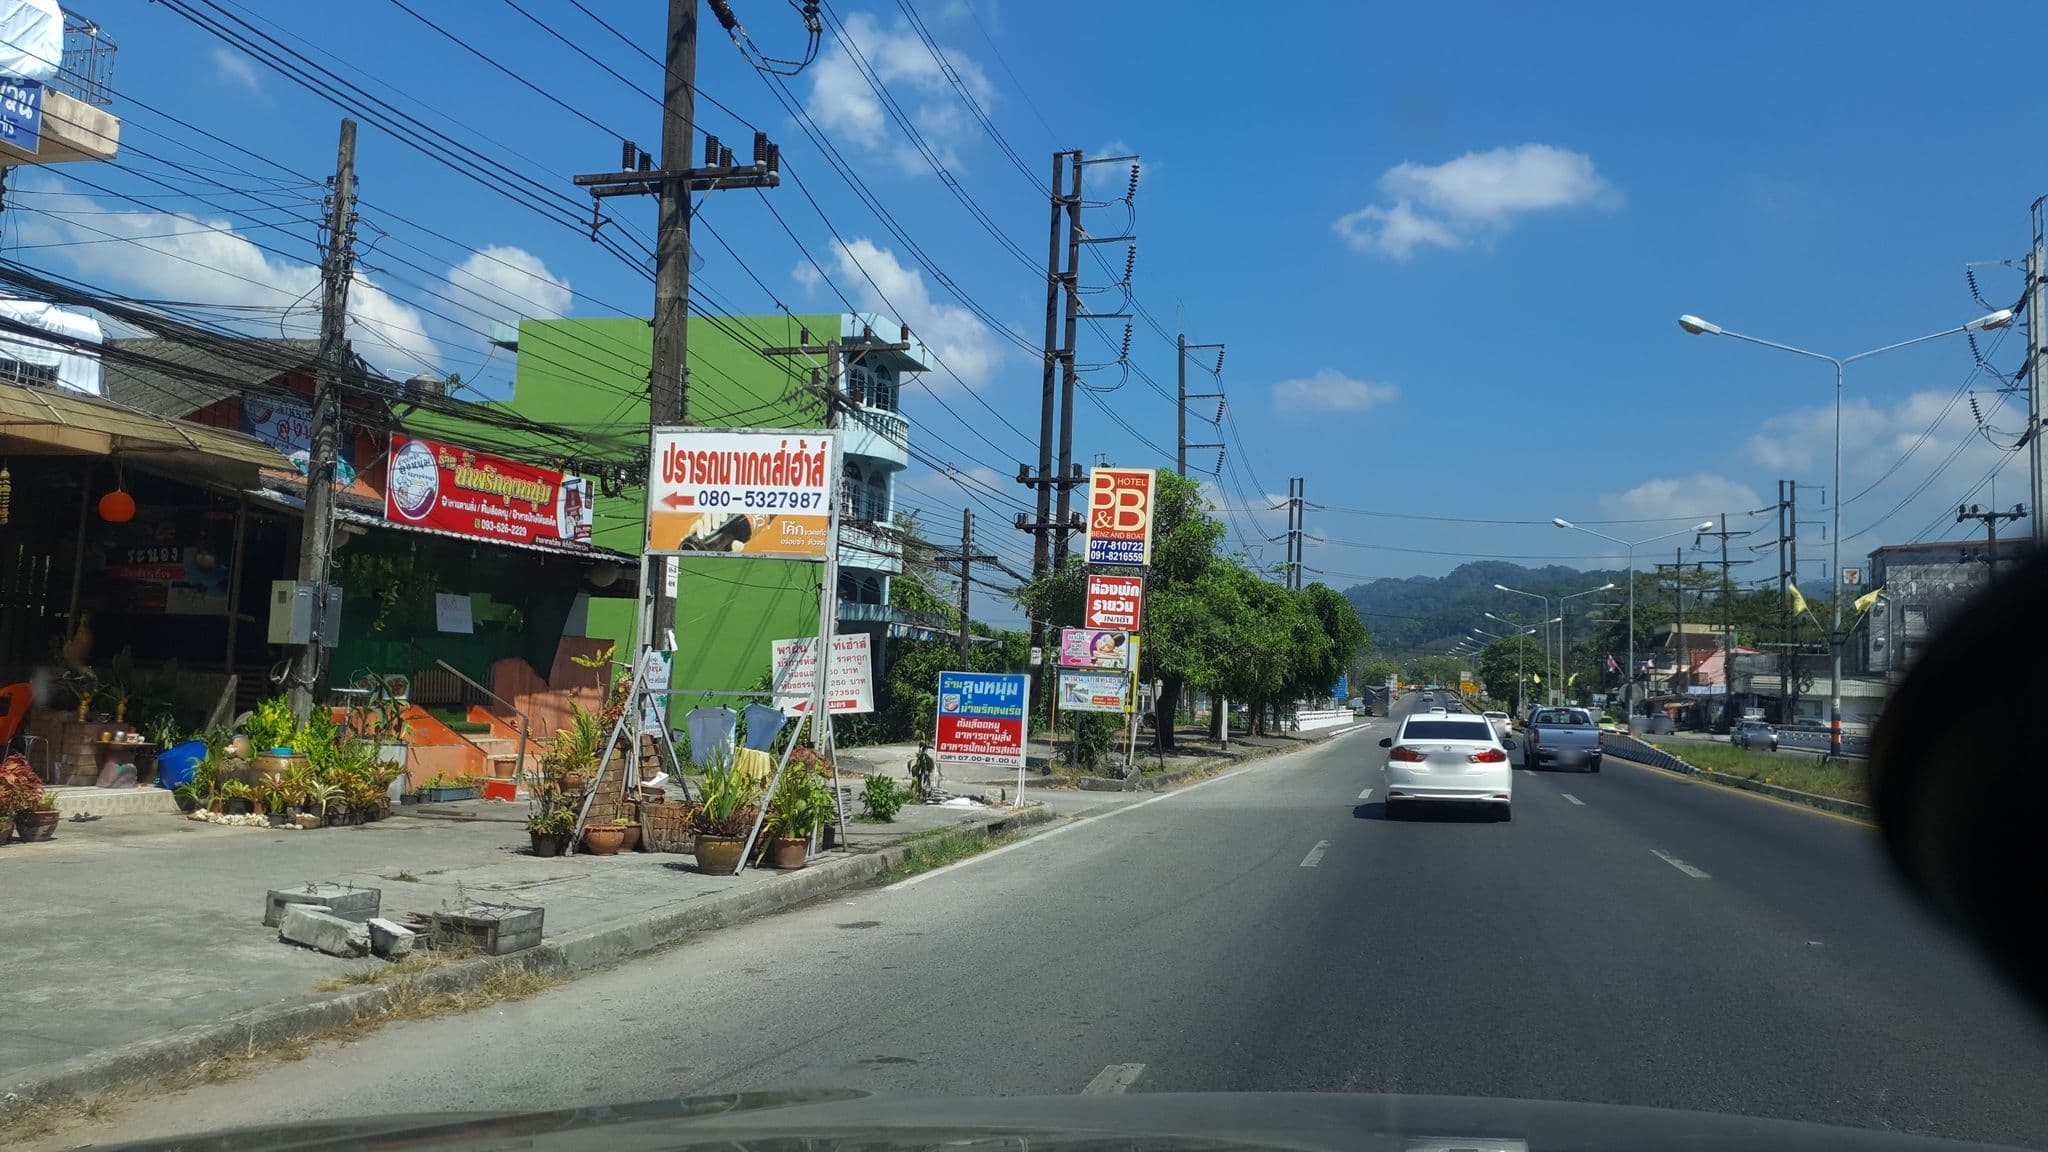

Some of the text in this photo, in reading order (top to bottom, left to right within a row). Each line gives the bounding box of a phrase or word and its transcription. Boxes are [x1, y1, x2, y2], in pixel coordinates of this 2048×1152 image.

[1117, 478, 1147, 486] HOTEL
[698, 490, 821, 509] 080-5327987
[481, 519, 527, 536] 093-626-2229
[782, 520, 804, 536] โค้ก
[1091, 541, 1143, 551] 077-810722
[1091, 578, 1139, 597] ห้องพัก
[1093, 597, 1134, 612] รายวัน
[944, 677, 1018, 701] ร้าน ลุงหนุ่ม
[956, 718, 1000, 733] ต้มเลือดหมู
